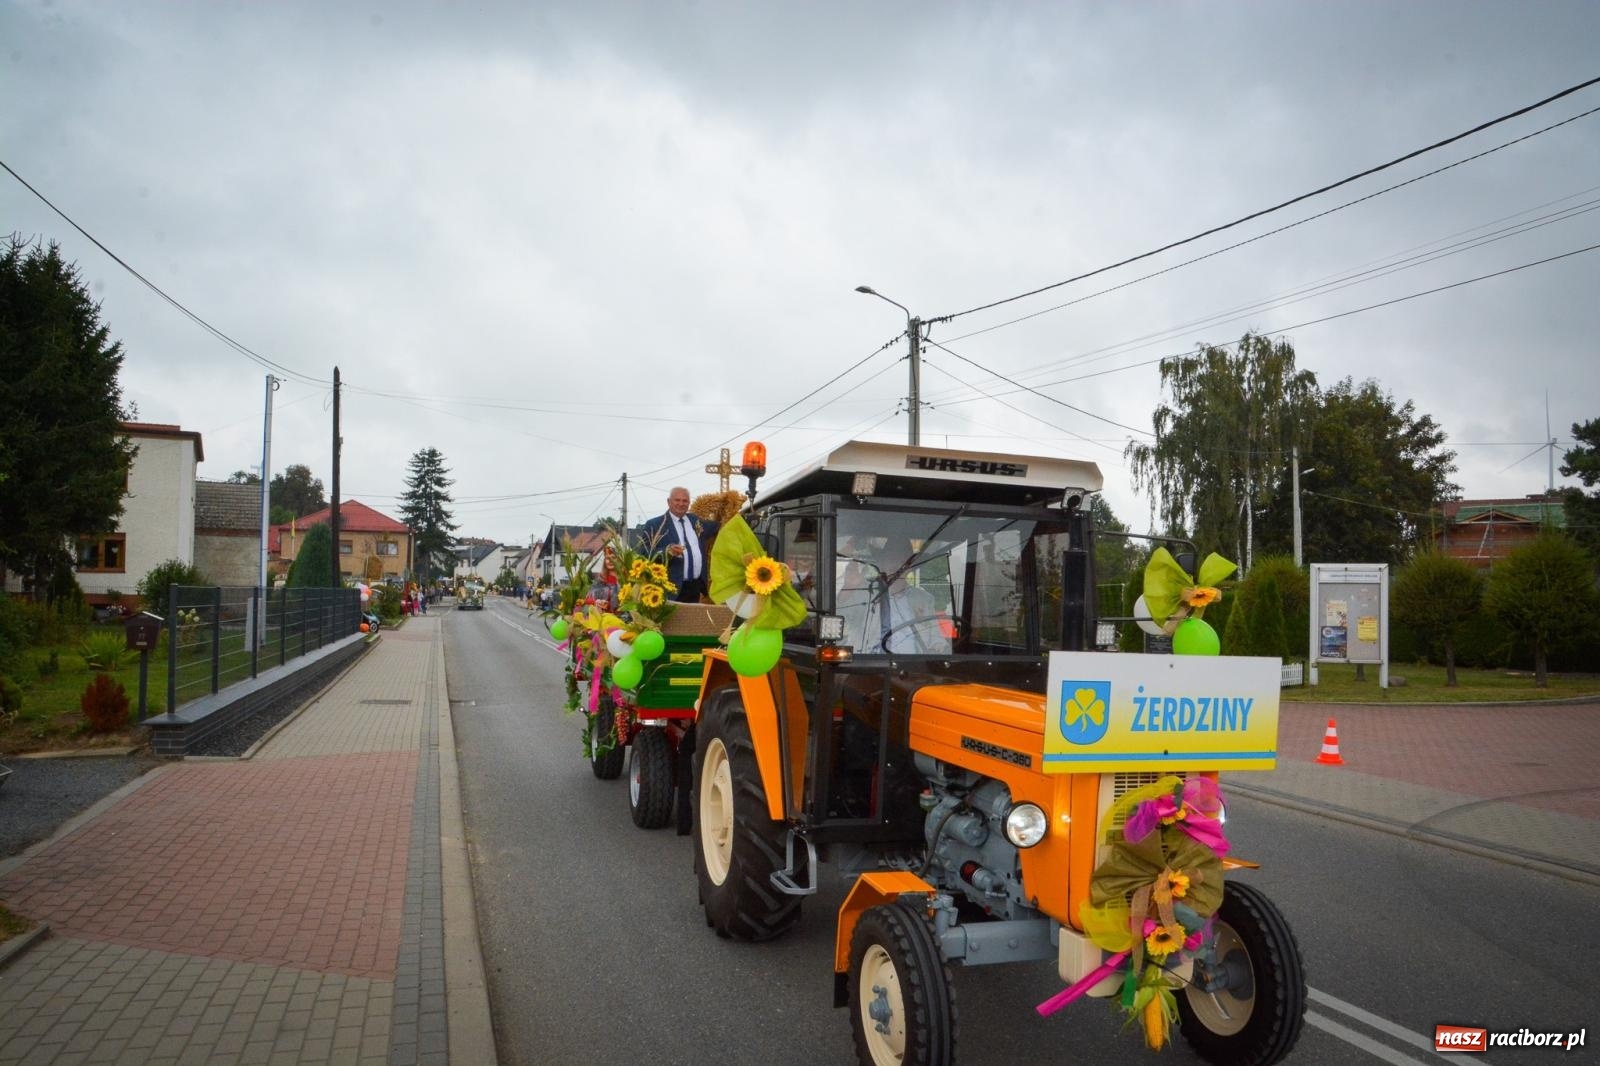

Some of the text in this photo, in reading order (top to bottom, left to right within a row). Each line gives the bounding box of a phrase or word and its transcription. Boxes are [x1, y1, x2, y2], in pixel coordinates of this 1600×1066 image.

[910, 457, 1024, 475] URSUS
[1131, 685, 1254, 732] ŻERDZINY
[962, 736, 1001, 758] URSUS
